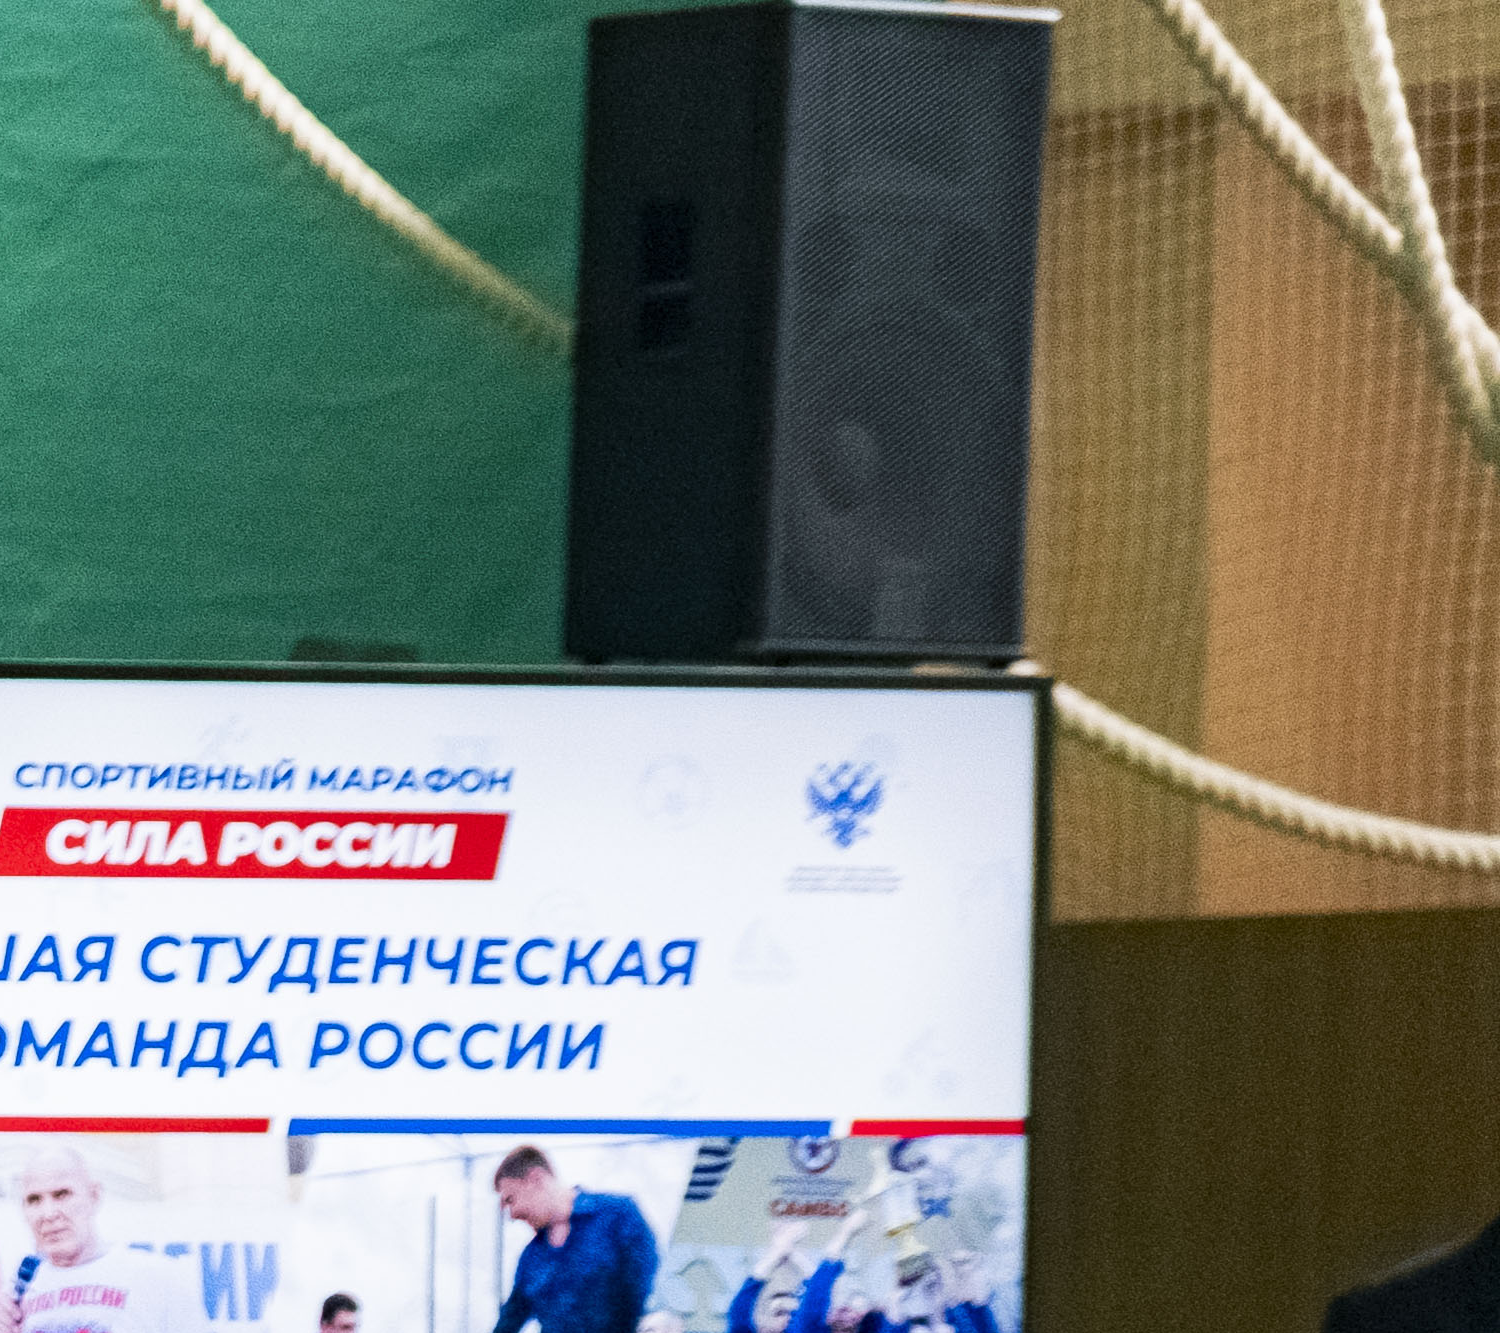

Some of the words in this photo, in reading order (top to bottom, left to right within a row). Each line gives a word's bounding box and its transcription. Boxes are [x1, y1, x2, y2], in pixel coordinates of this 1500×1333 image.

[13, 758, 297, 791] СПОРТИВНЫЙ
[307, 766, 514, 793] МАРАФОН
[45, 818, 208, 866] СИЛА
[216, 821, 459, 869] РОССИИ
[138, 934, 701, 993] СТУДЕНЧЕСКАЯ
[309, 1021, 608, 1071] РОССИИ
